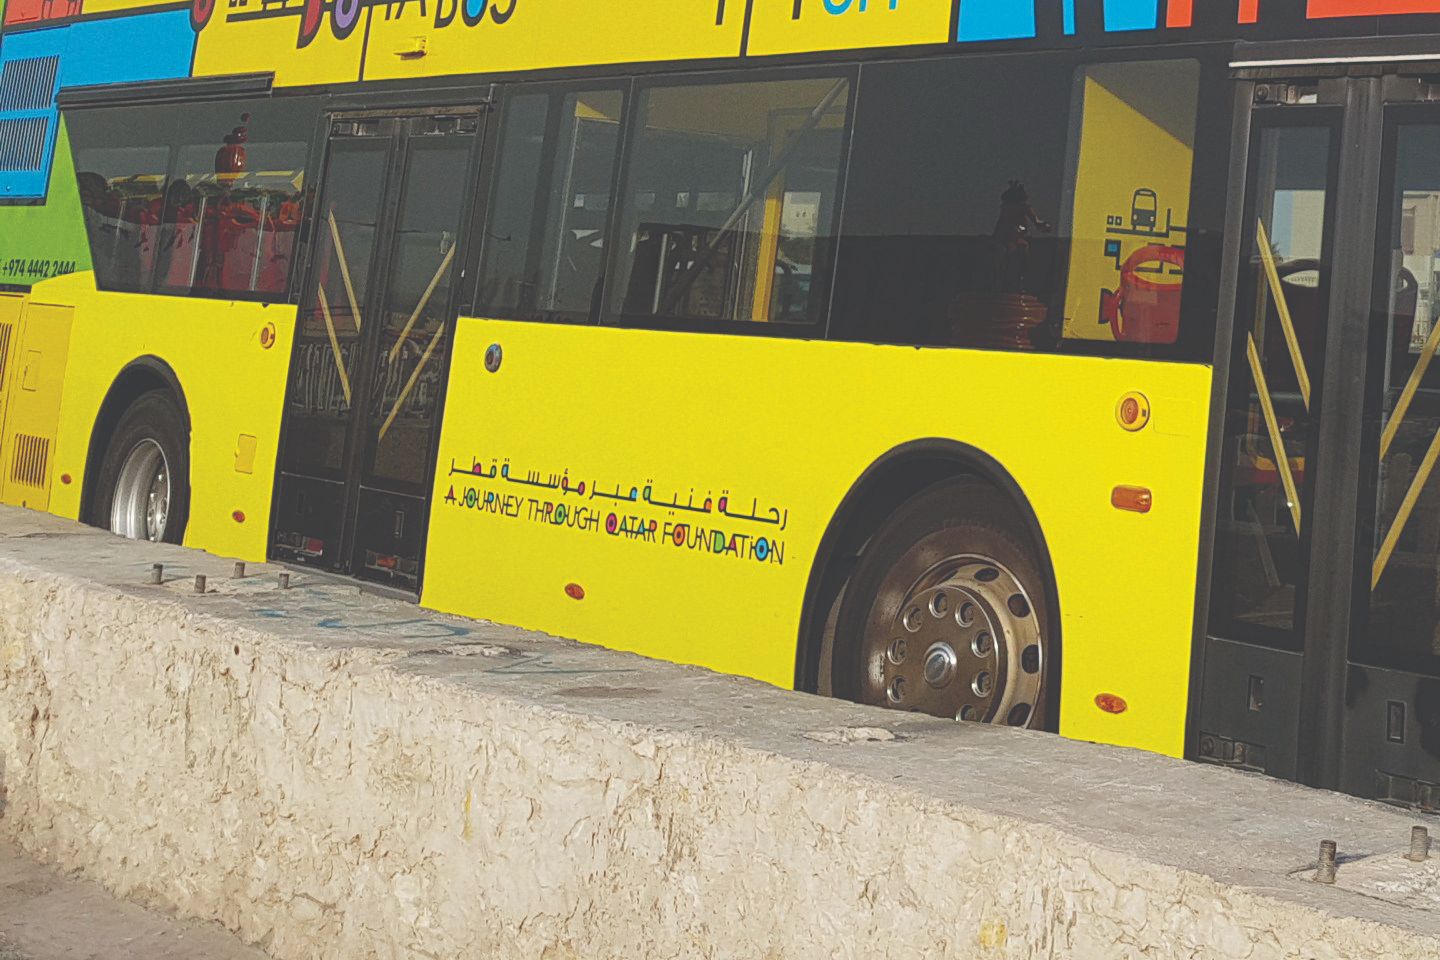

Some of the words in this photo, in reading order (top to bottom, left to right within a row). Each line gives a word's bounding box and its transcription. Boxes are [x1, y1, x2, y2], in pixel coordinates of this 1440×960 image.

[3, 259, 26, 277] +974
[27, 259, 50, 278] 4442
[448, 455, 497, 479] قطر
[444, 485, 457, 505] A
[458, 486, 524, 518] JOURNEY
[528, 498, 600, 532] THROUGH
[606, 512, 657, 543] QATAR
